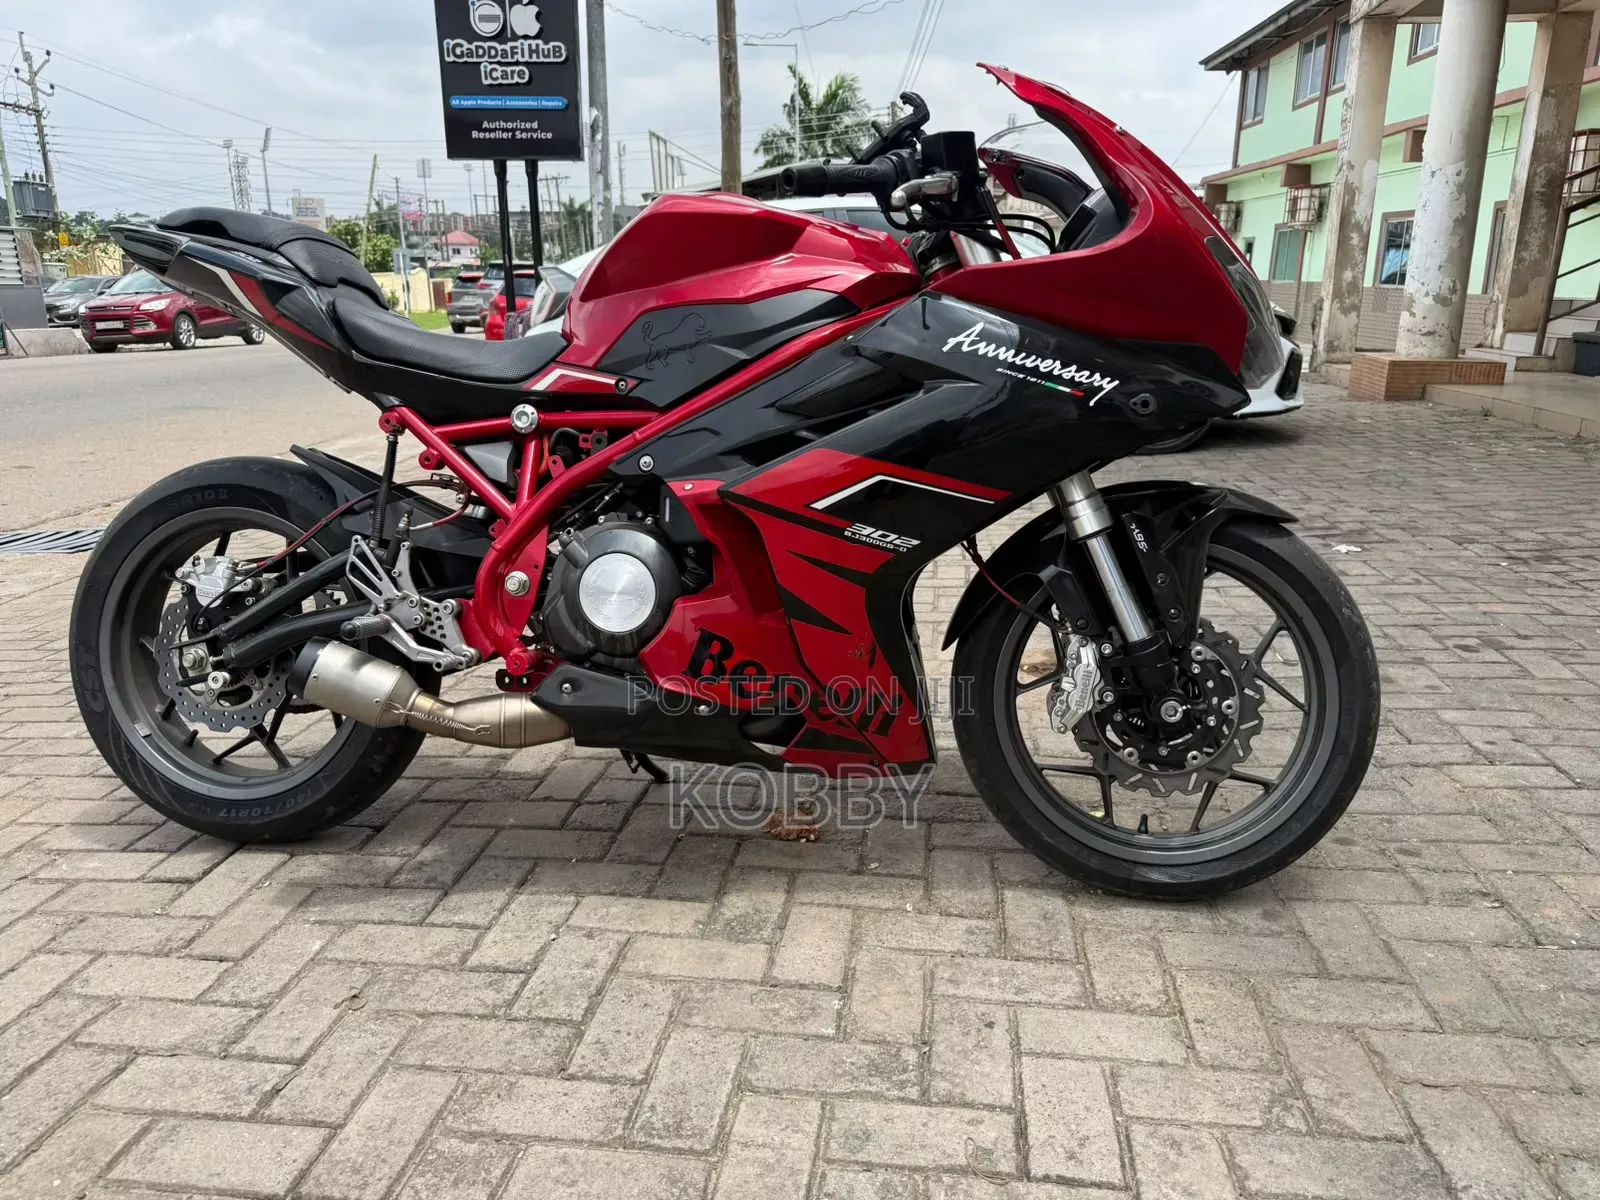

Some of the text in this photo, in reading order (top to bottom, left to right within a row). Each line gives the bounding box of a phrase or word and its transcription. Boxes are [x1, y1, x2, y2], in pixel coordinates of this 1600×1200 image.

[482, 64, 528, 83] iCare
[461, 99, 477, 107] Apple
[482, 120, 538, 129] Authorized
[472, 130, 553, 139] Reseller Service
[942, 321, 1121, 407] Anniversary
[996, 367, 1026, 379] SINCE
[846, 522, 922, 548] 302
